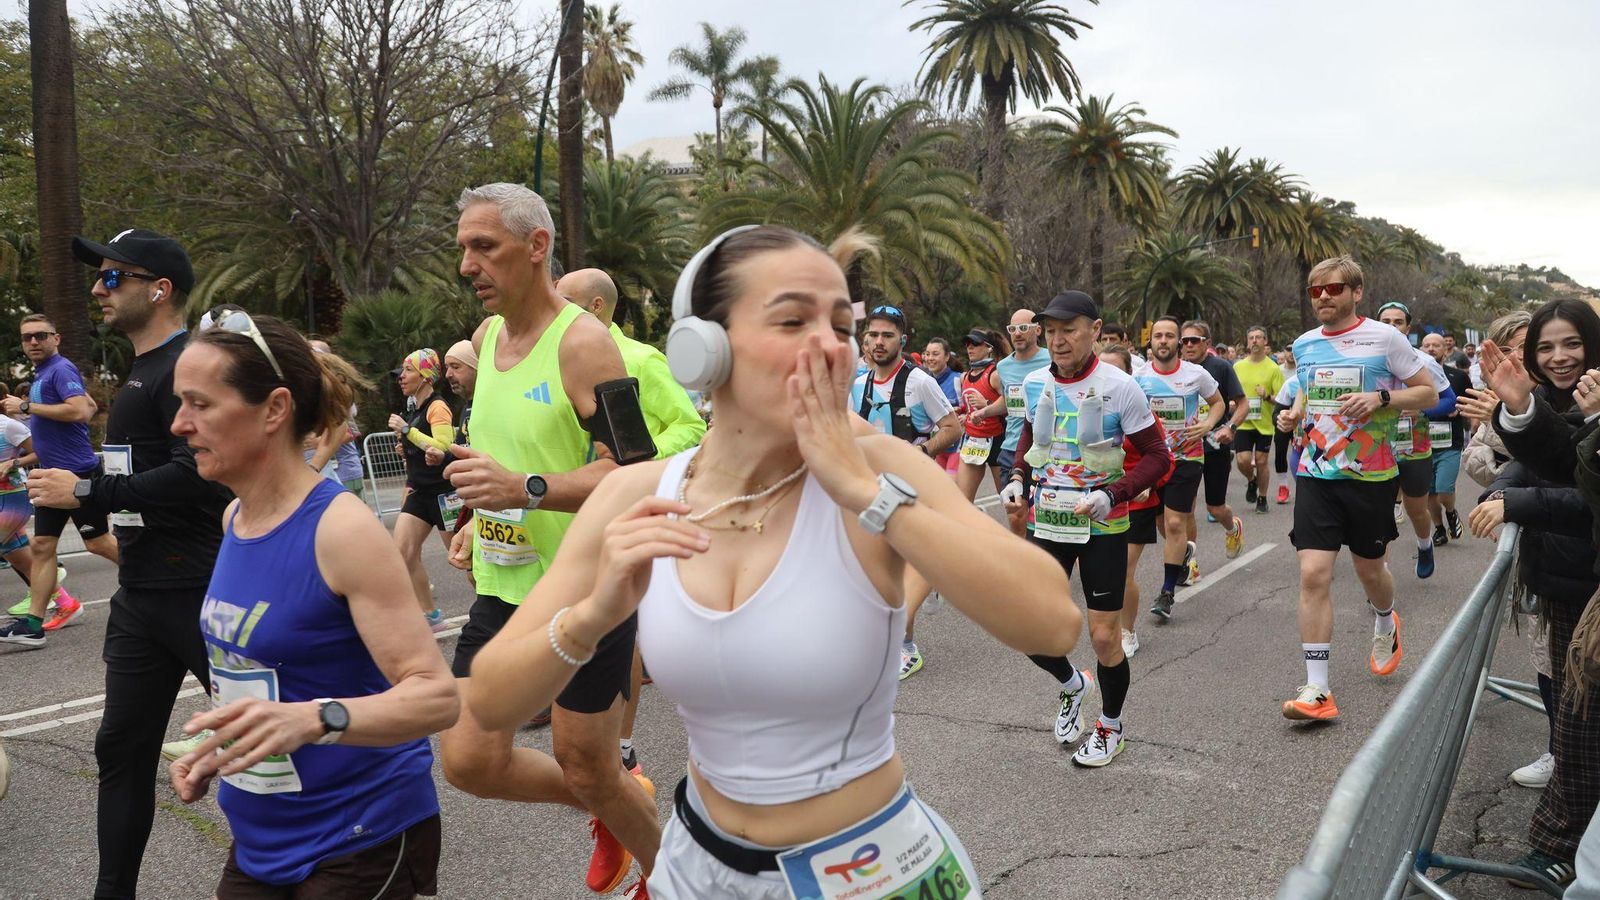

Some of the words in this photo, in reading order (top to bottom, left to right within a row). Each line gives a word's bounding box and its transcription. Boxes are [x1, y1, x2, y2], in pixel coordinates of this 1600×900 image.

[1045, 510, 1080, 526] 5305
[479, 518, 516, 545] 2562
[896, 851, 908, 864] 1/2
[900, 863, 912, 875] DE
[835, 874, 893, 900] TotalEnergies
